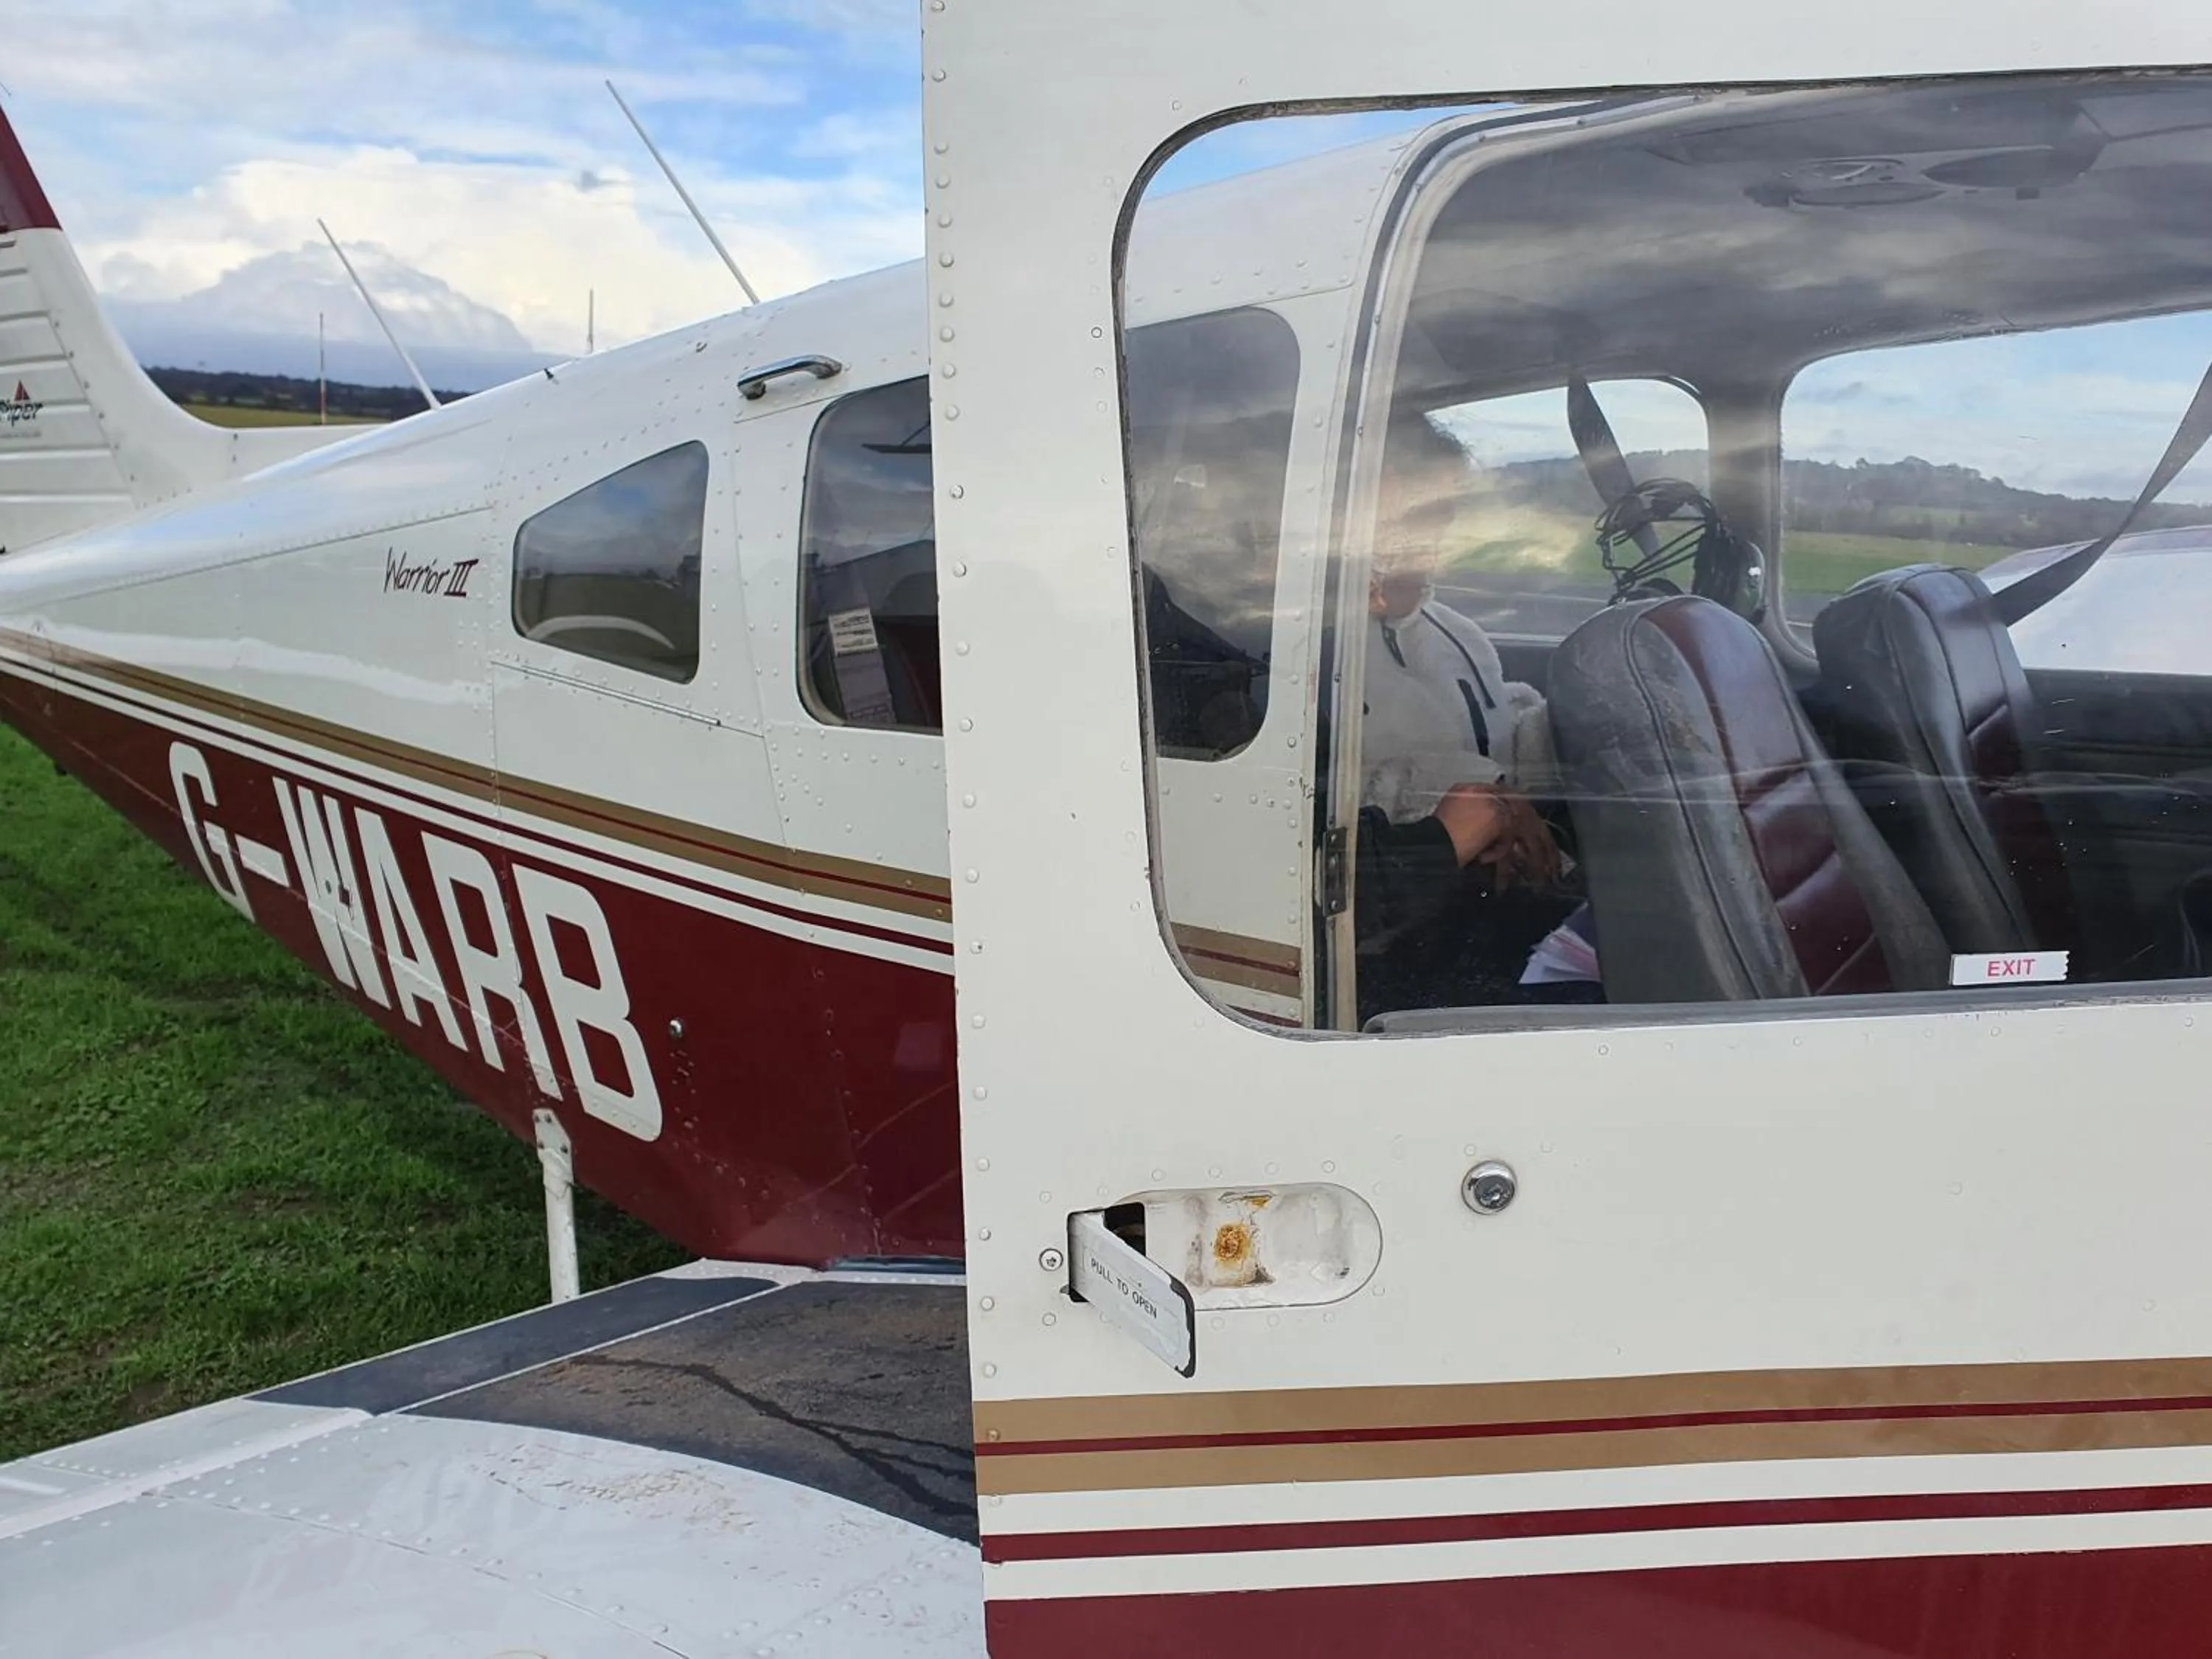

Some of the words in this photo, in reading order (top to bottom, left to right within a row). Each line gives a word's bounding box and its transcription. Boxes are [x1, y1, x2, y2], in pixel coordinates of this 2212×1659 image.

[383, 546, 450, 594] Warrior
[444, 558, 479, 598] III
[169, 741, 662, 1142] G-WARB
[1987, 959, 2036, 977] EXIT
[1091, 1257, 1113, 1284] PULL
[1116, 1277, 1129, 1295] TO
[1132, 1291, 1157, 1319] OPEN
